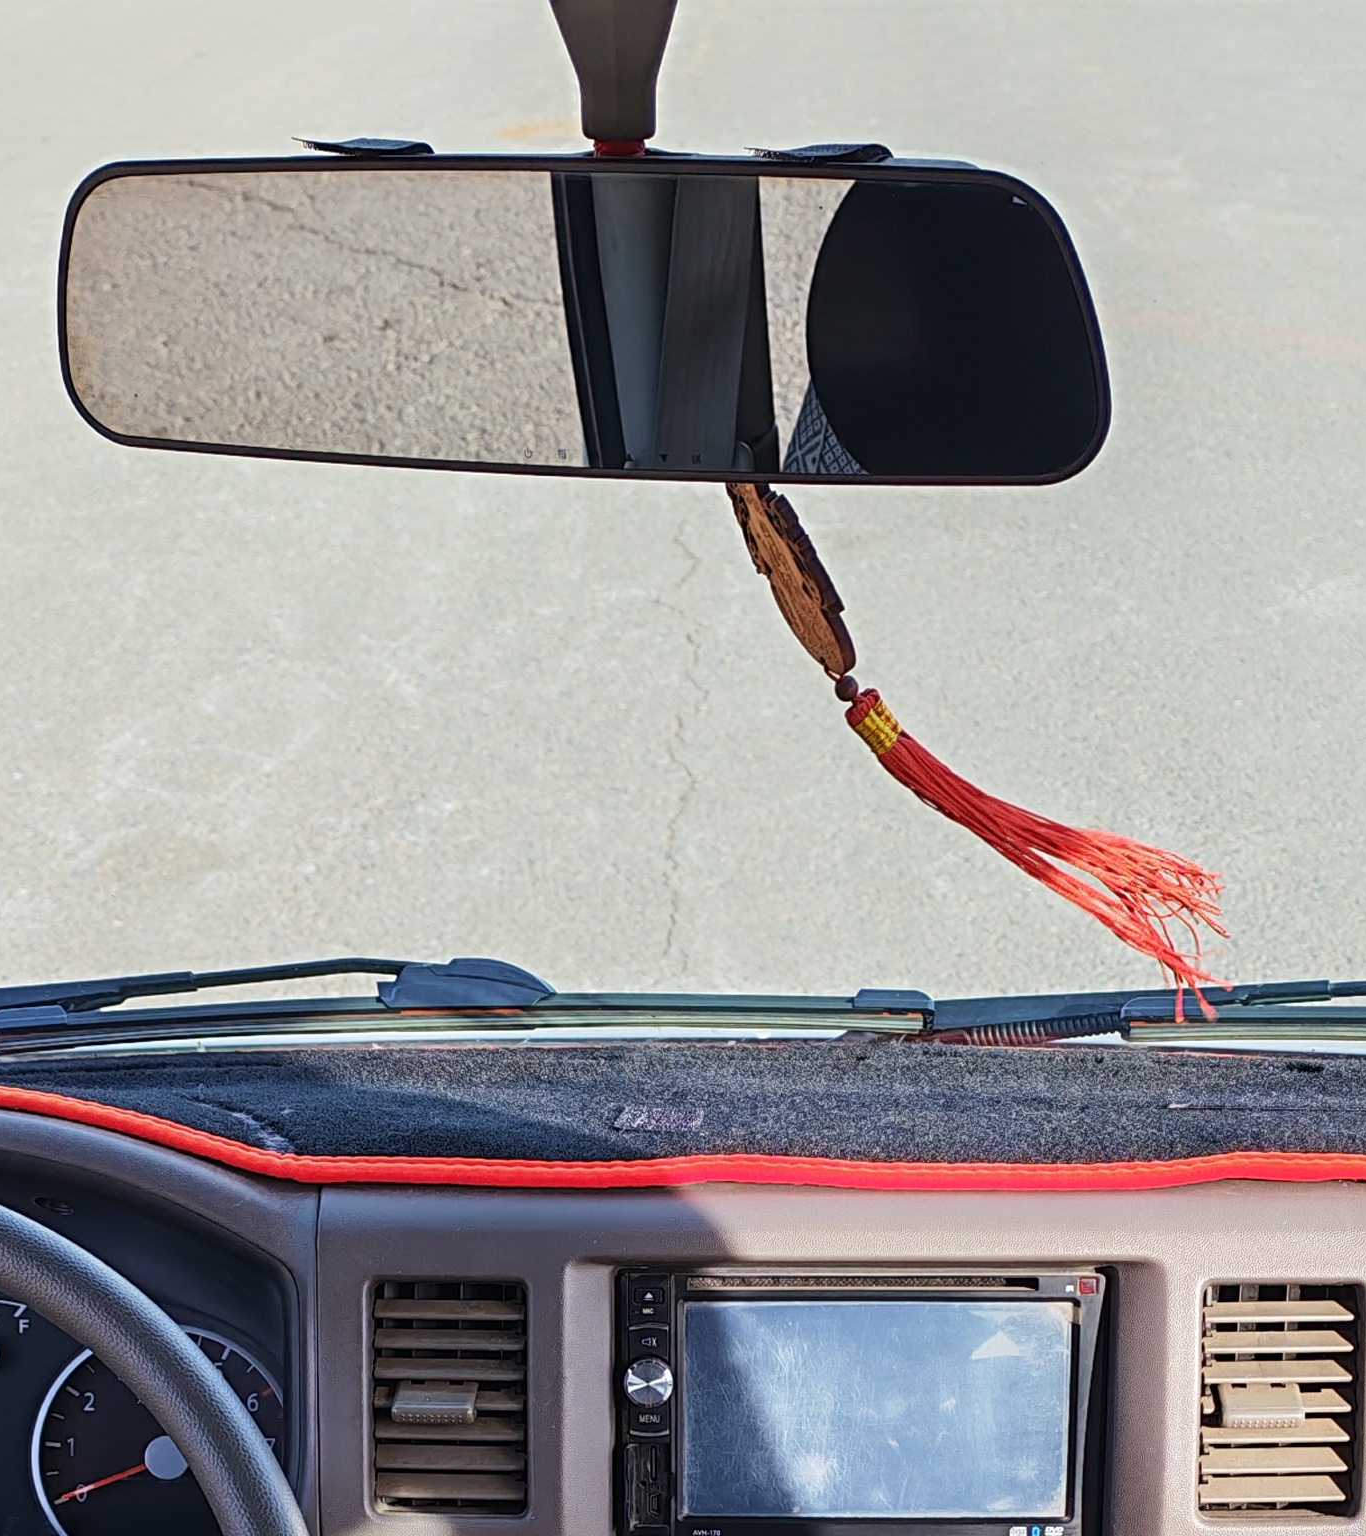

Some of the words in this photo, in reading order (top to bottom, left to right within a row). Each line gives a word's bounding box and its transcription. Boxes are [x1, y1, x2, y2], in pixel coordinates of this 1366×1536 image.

[18, 1319, 30, 1334] F
[83, 1392, 96, 1412] 2
[246, 1393, 259, 1412] 6
[638, 1414, 661, 1424] MENU
[66, 1437, 75, 1457] 1
[75, 1484, 88, 1503] 0
